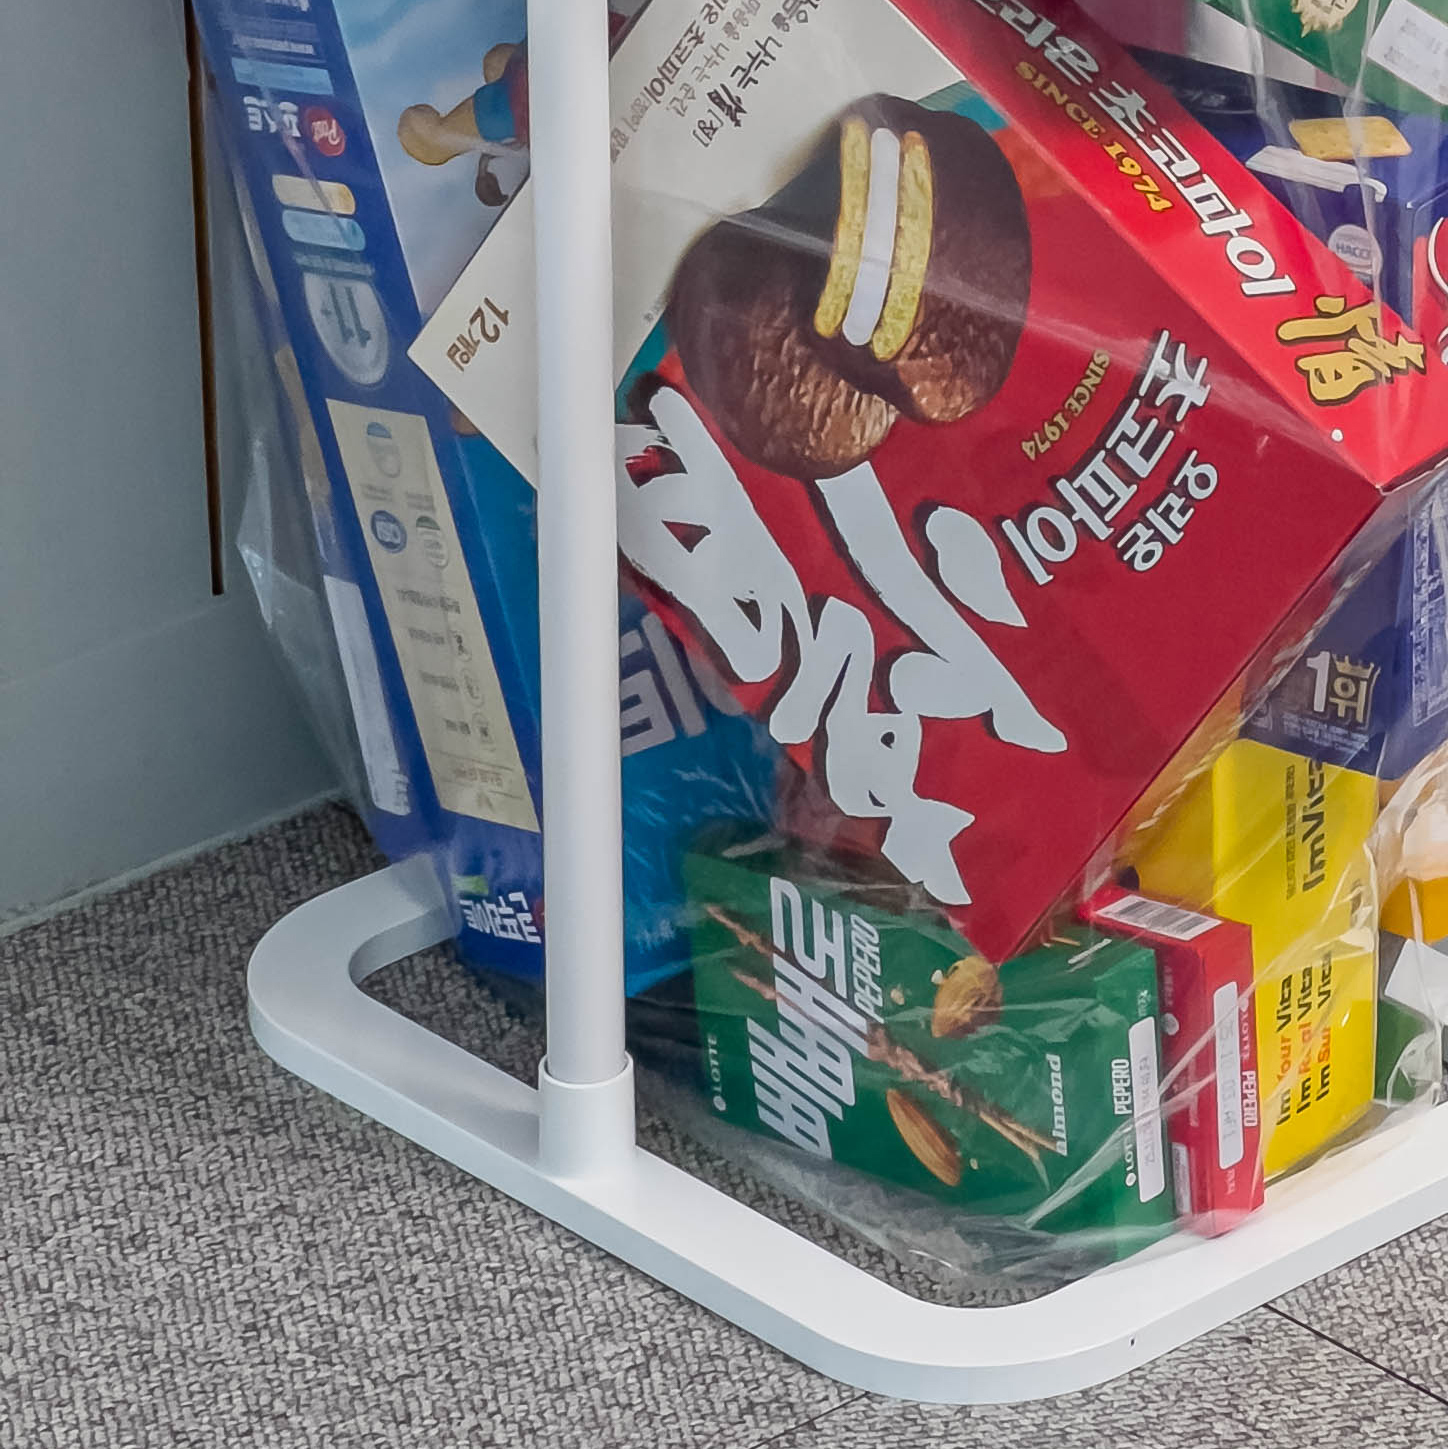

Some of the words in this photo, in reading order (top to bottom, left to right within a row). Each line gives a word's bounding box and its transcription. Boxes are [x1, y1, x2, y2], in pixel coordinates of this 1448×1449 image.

[690, 39, 731, 84] 나누는
[729, 34, 784, 91] 나누는
[1013, 59, 1107, 142] SINCE
[1103, 139, 1175, 214] 1974
[1088, 78, 1297, 298] 초코파이
[1060, 349, 1113, 420] SINCE
[1000, 327, 1212, 587] 초코파이
[1020, 412, 1068, 463] 1974
[1115, 447, 1220, 574] 오리온
[1304, 651, 1373, 725] 1위
[848, 912, 885, 1025] PEPERO
[1276, 972, 1295, 1034] Vita
[1296, 964, 1315, 1023] Vita
[706, 1032, 723, 1099] LOTTE
[1110, 1057, 1132, 1116] PEPERO
[1241, 1069, 1258, 1128] PEPERO
[1050, 1053, 1068, 1157] almond
